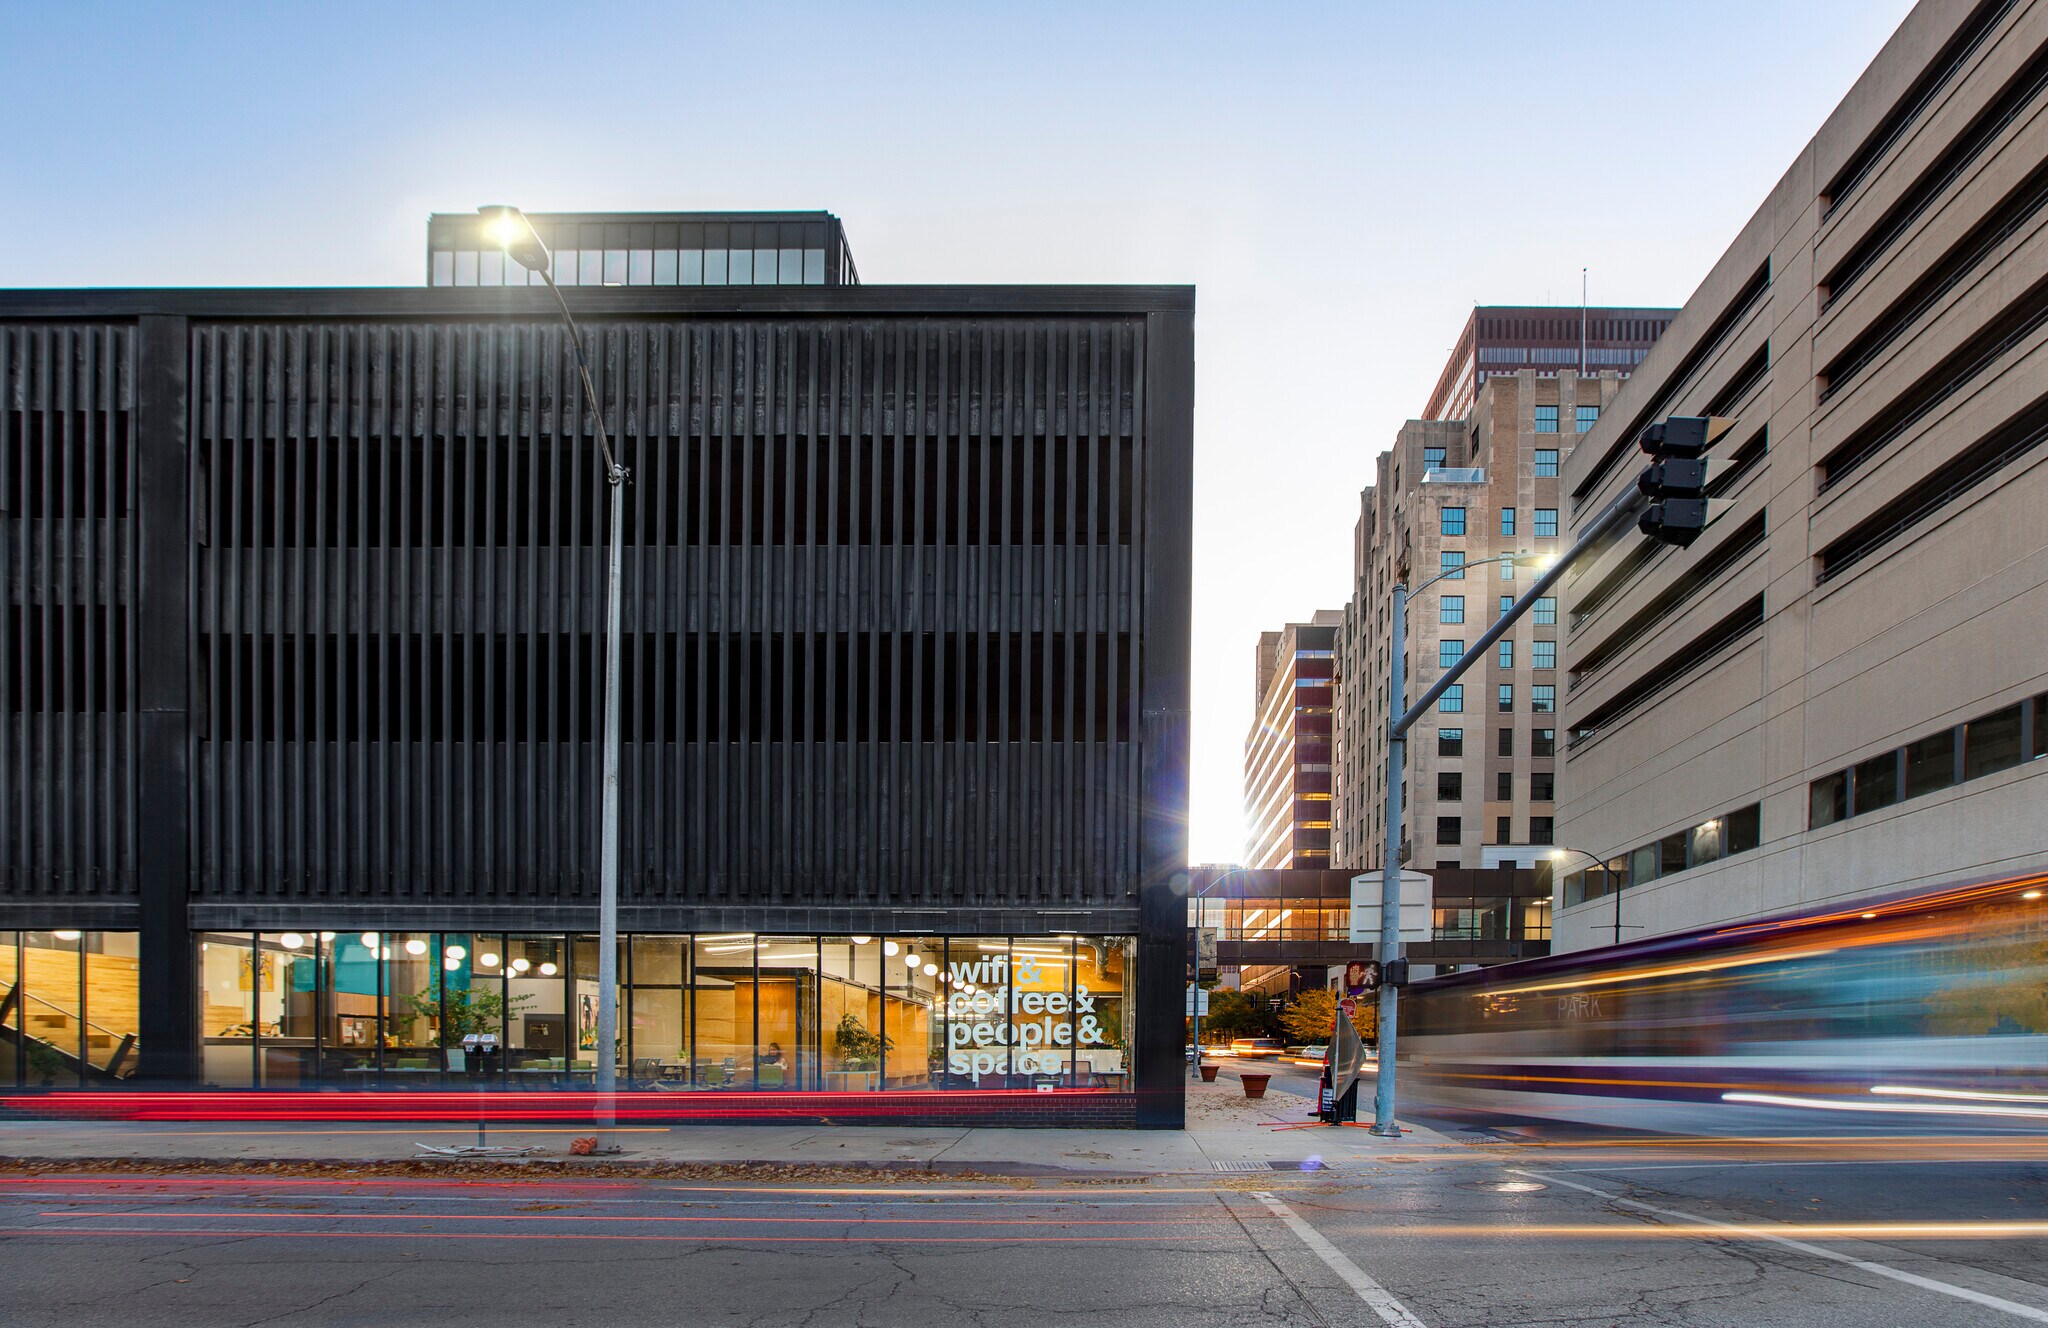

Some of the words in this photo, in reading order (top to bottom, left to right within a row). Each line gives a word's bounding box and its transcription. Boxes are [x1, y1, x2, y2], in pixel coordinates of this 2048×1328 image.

[950, 955, 1009, 984] wifi
[1016, 956, 1043, 984] &
[1558, 993, 1602, 1019] PARK
